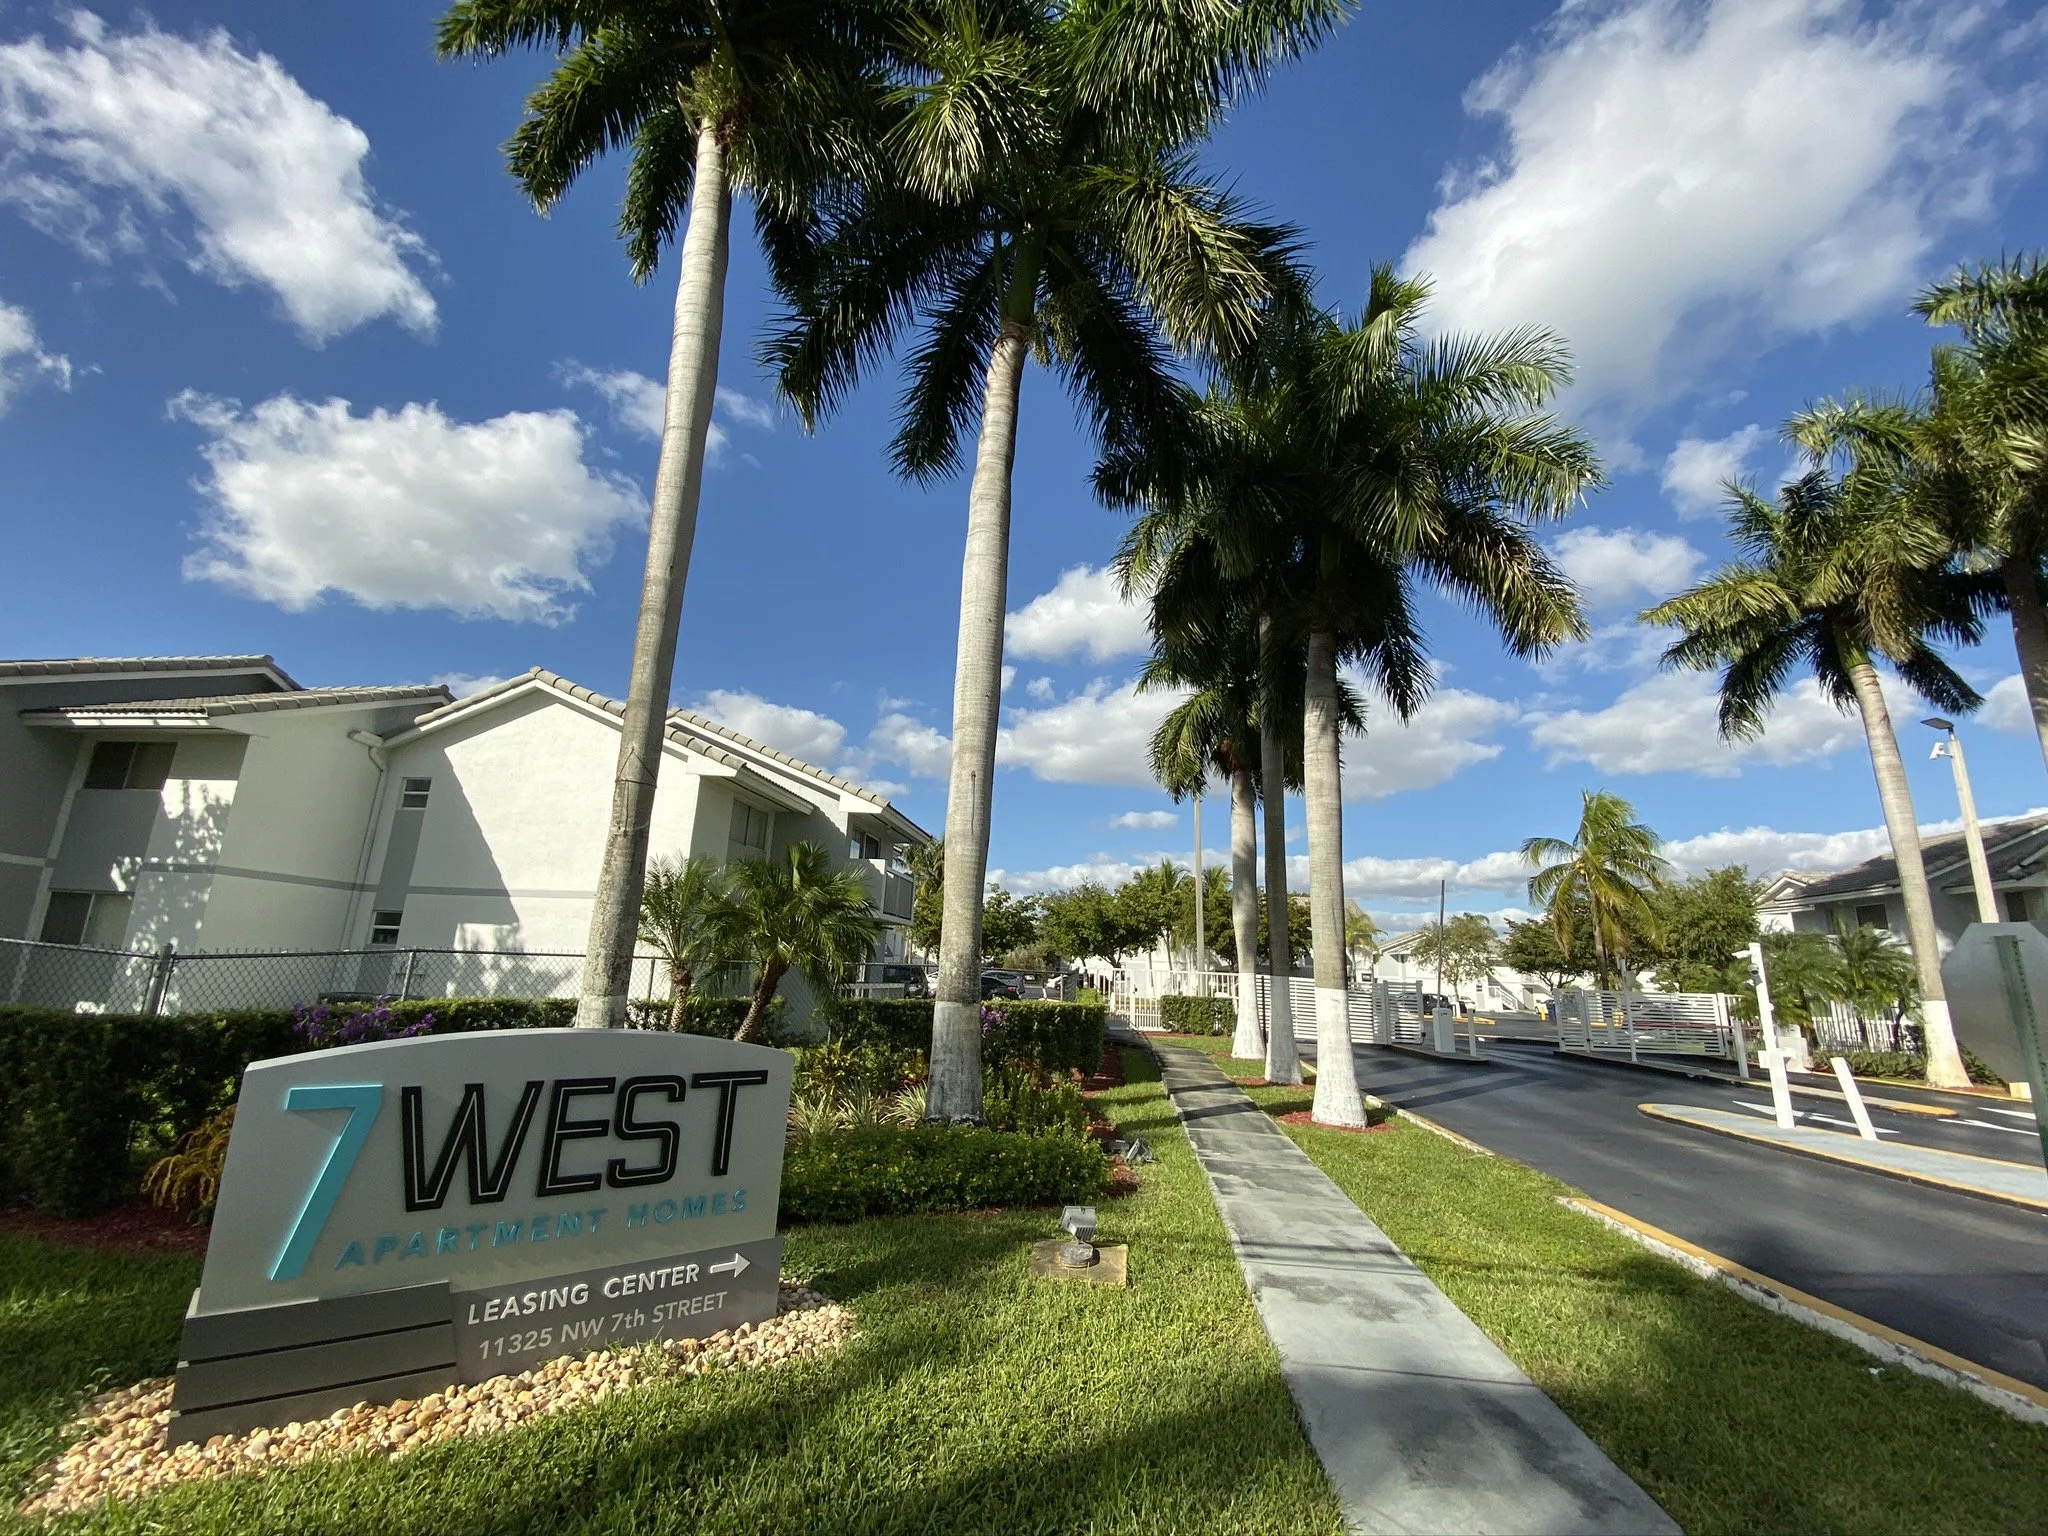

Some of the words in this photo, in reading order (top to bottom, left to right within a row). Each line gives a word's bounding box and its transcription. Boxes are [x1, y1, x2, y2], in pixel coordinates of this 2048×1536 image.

[267, 1083, 384, 1281] 7
[401, 1069, 769, 1212] WEST
[335, 1208, 608, 1270] APARTMENT
[626, 1188, 748, 1230] HOMES
[467, 1283, 590, 1325] LEASING
[603, 1263, 700, 1299] CENTER
[479, 1325, 552, 1360] 11325
[560, 1317, 604, 1344] NW
[611, 1309, 645, 1333] 7th
[652, 1292, 728, 1323] STREET
